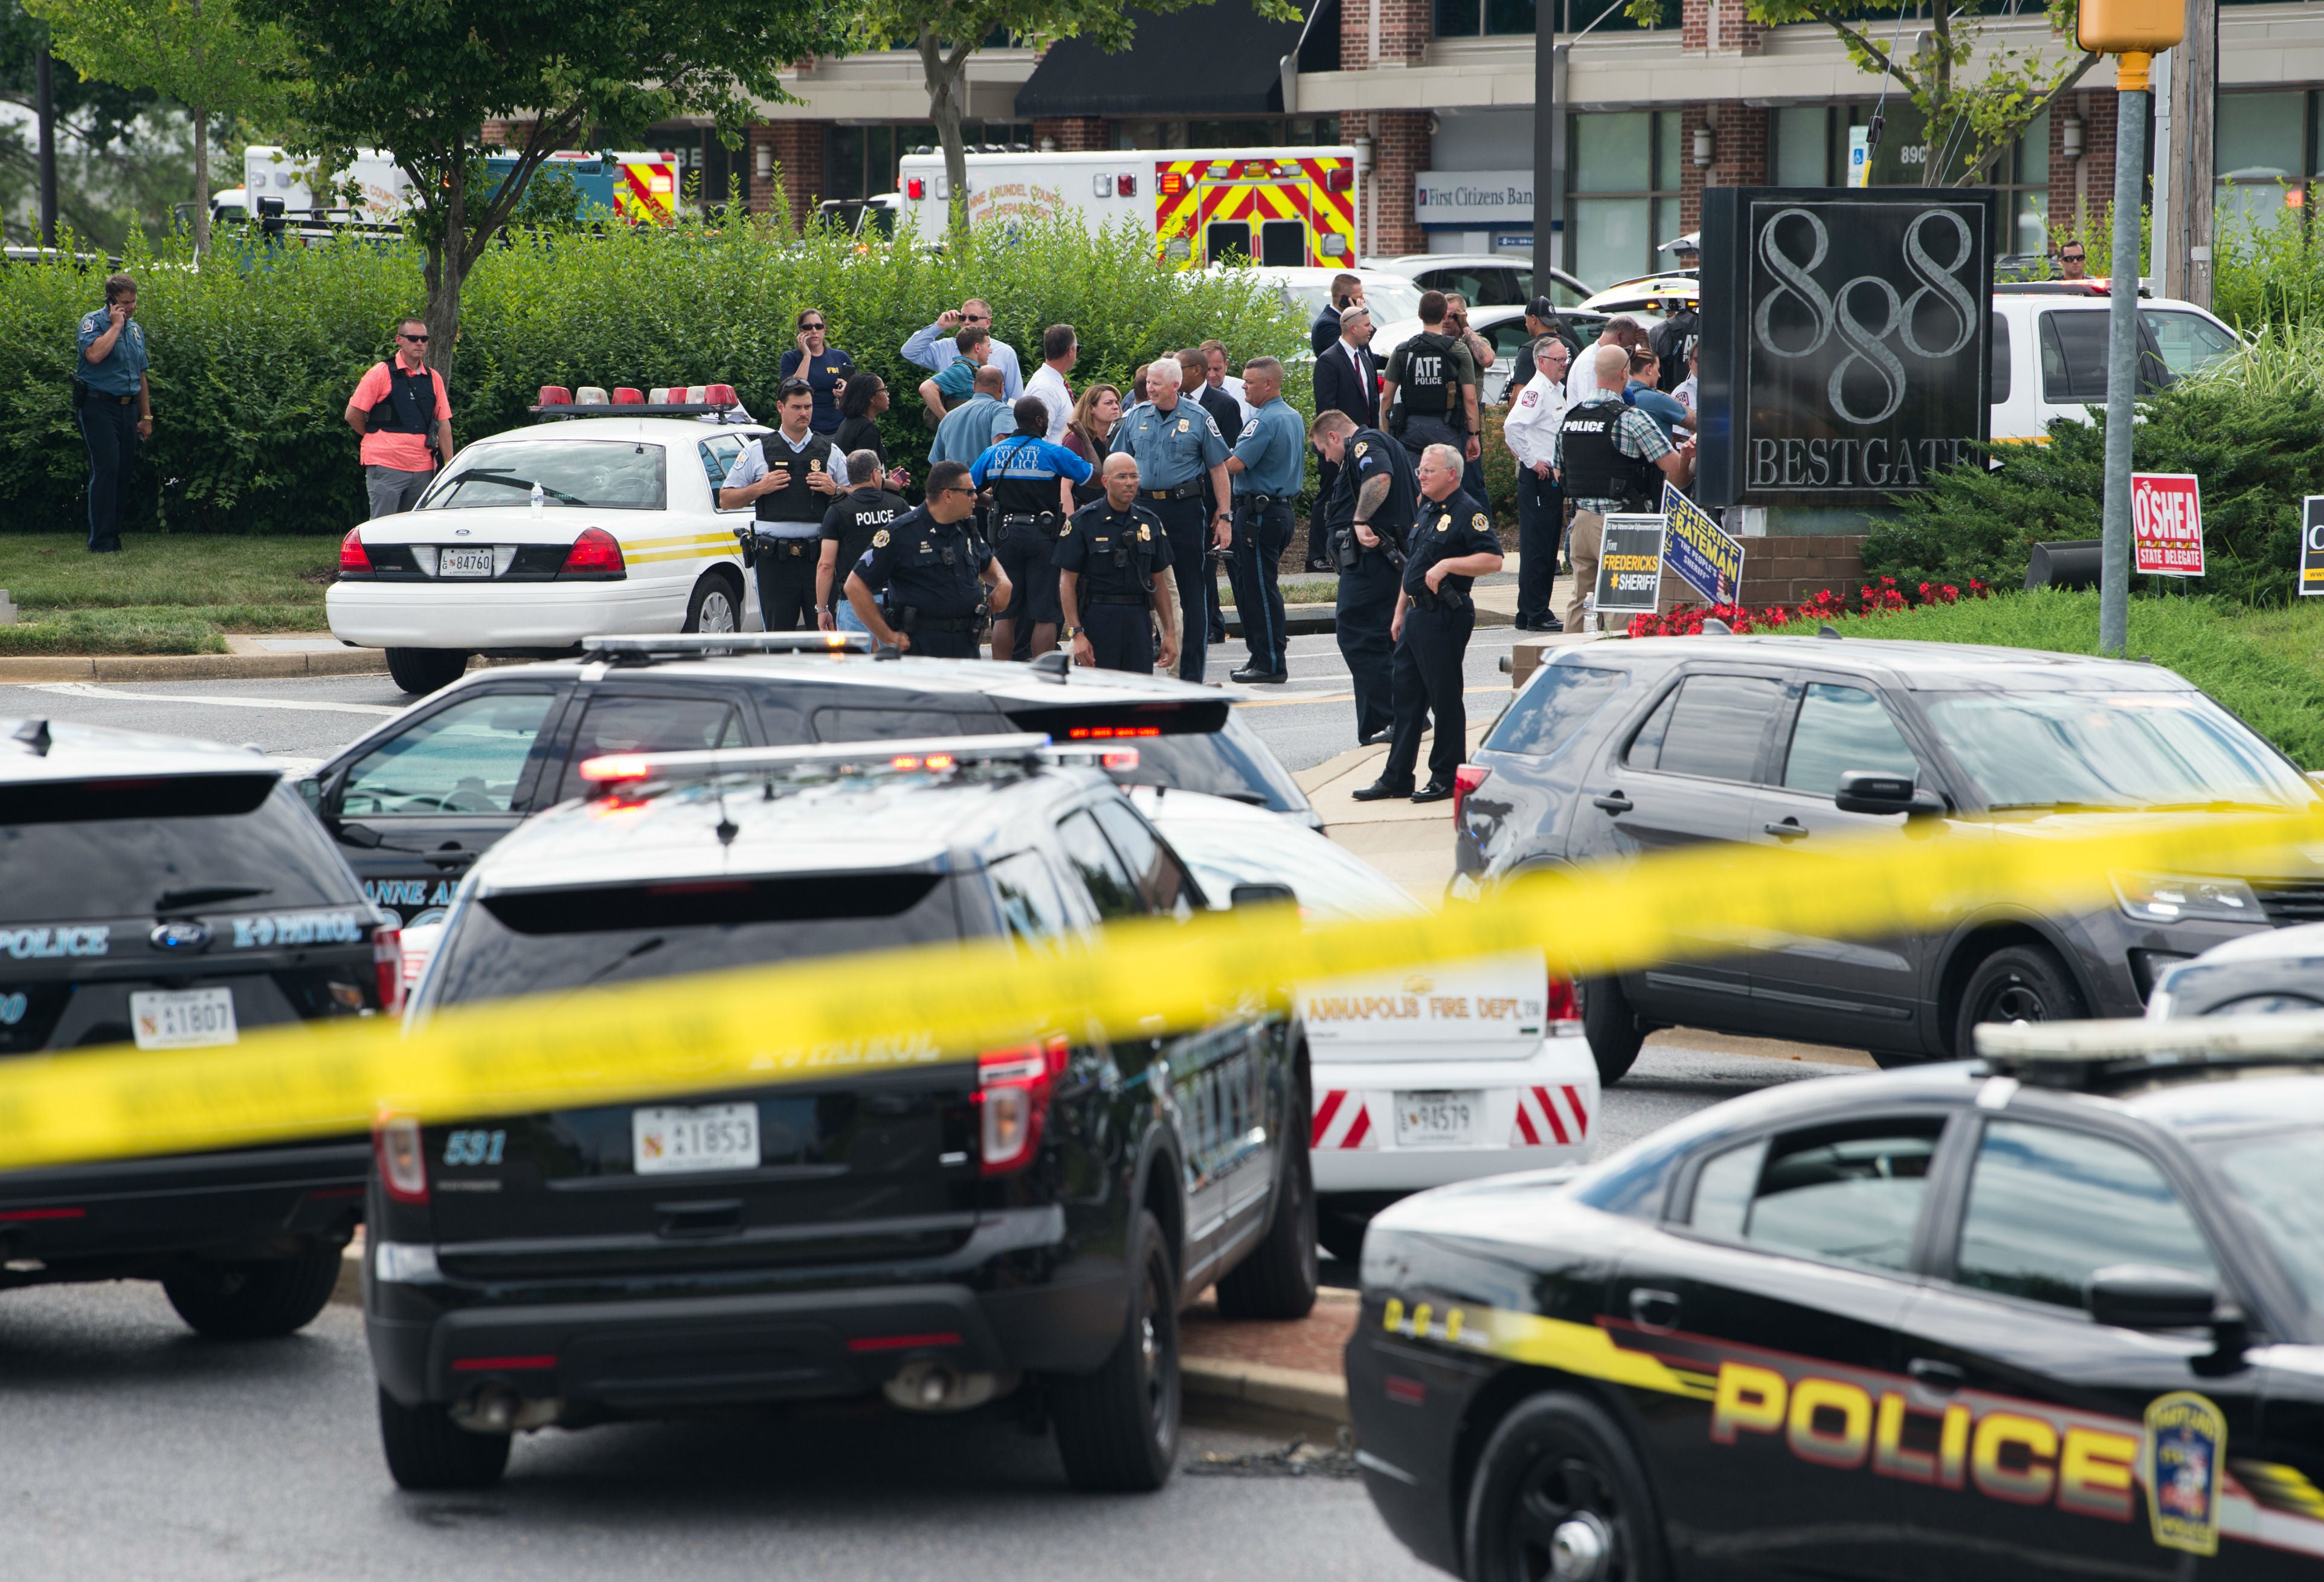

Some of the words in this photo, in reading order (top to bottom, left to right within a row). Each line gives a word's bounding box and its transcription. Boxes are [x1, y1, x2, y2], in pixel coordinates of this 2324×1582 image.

[370, 184, 401, 208] COUNTY
[1429, 188, 1452, 206] First
[1455, 186, 1504, 206] Citizens
[1415, 357, 1441, 377] ATF
[1415, 376, 1442, 385] POLICE
[1562, 421, 1605, 432] POLICE
[994, 450, 1040, 460] COUNTY
[994, 459, 1039, 470] POLICE
[1752, 438, 1969, 485] BESTGATE
[856, 509, 894, 526] POLICE
[1664, 488, 1678, 557] RE-ELECT
[1678, 500, 1740, 558] SHERIFF
[1605, 539, 1618, 552] Jim
[1675, 511, 1738, 583] BATEMAN
[2140, 549, 2163, 564] STATE
[2165, 550, 2200, 566] DELEGATE
[457, 556, 489, 570] 84760
[1603, 555, 1658, 572] FREDERICKS
[1618, 574, 1656, 591] SHERIFF
[364, 880, 428, 905] ANNE
[232, 917, 275, 948] K-9
[276, 913, 362, 944] PATROL
[181, 1002, 228, 1035] 1807
[1308, 996, 1420, 1020] ANNAPOLIS
[1429, 997, 1469, 1019] FIRE
[1477, 997, 1522, 1019] DEPT.
[1418, 1105, 1470, 1131] 94579
[442, 1129, 507, 1166] 531
[692, 1119, 752, 1154] 1853
[1710, 1361, 2139, 1524] POLICE
